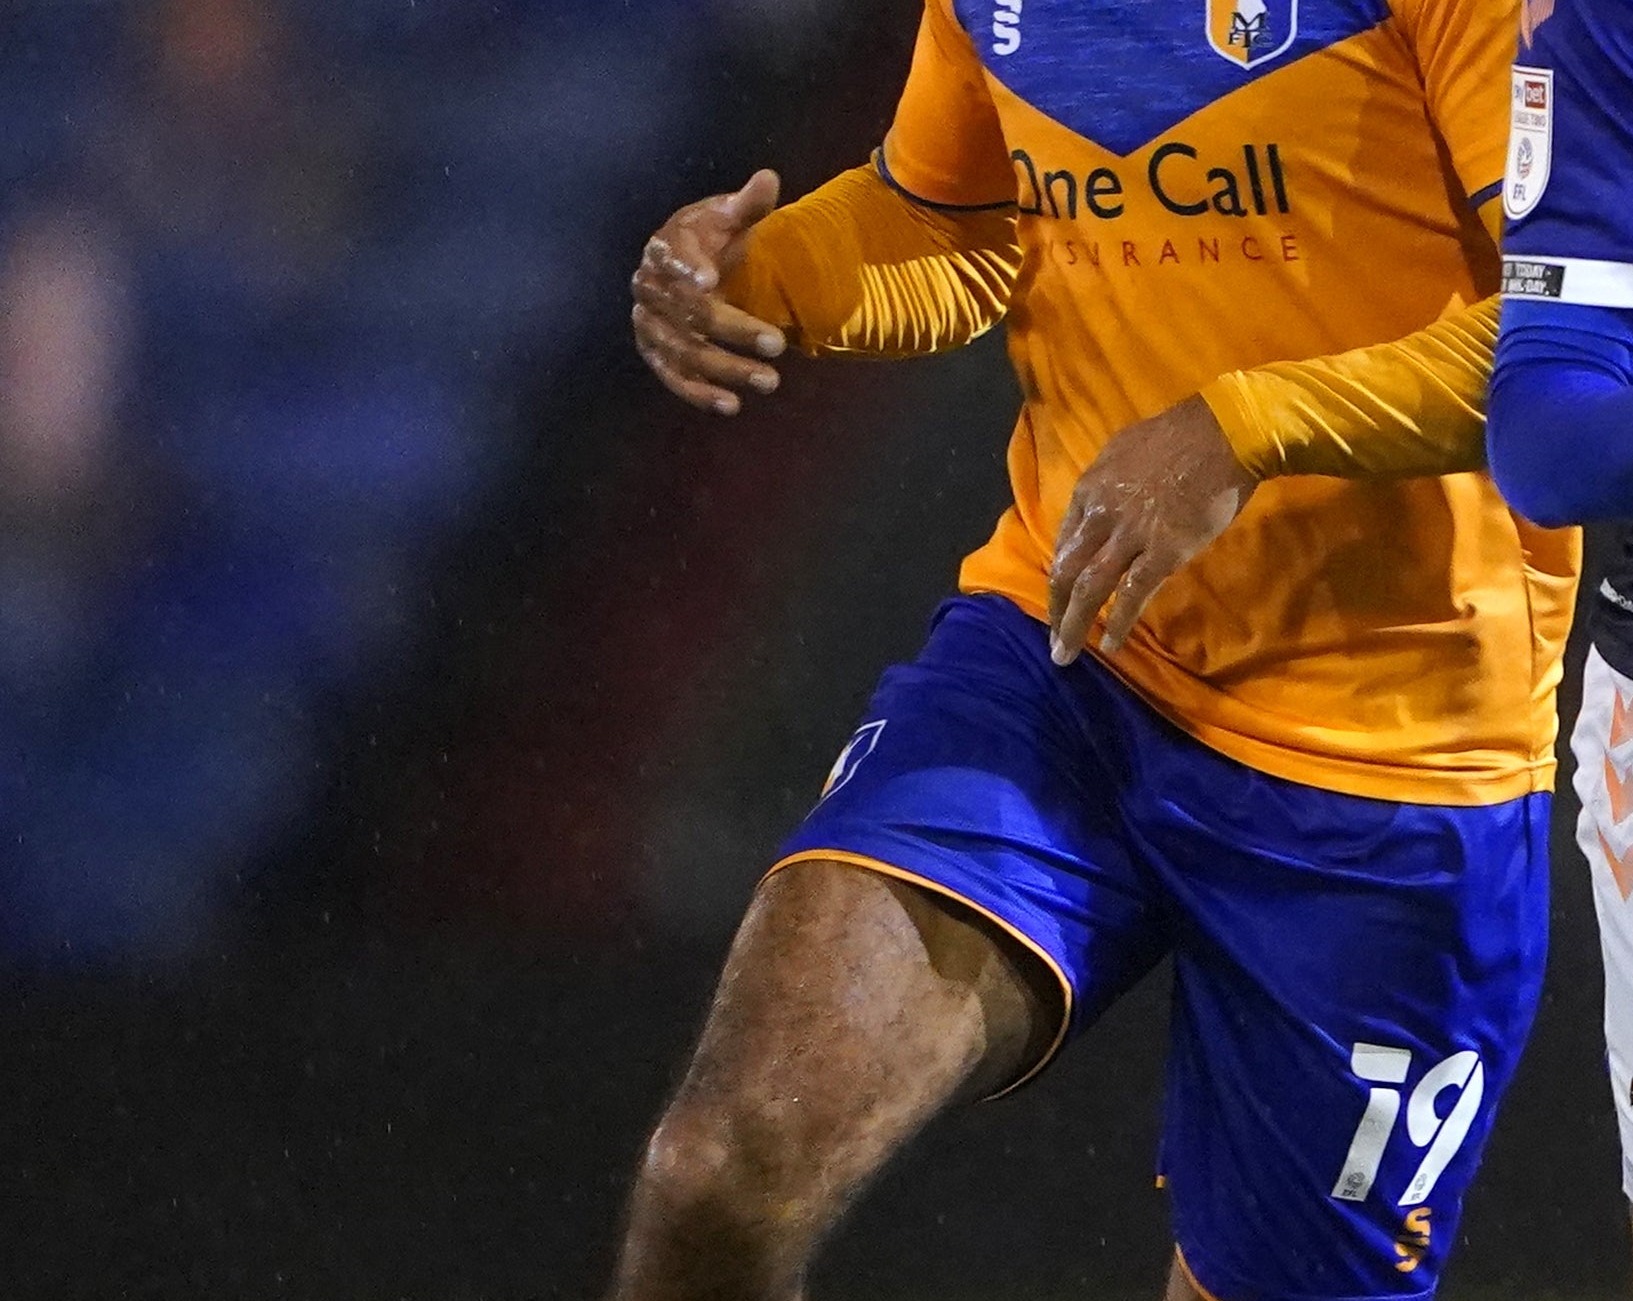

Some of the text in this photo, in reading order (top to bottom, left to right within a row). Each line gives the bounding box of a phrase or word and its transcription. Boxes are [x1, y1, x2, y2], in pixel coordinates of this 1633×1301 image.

[1147, 141, 1291, 218] Call
[1052, 234, 1300, 268] SURANCE
[1329, 1041, 1485, 1206] 19
